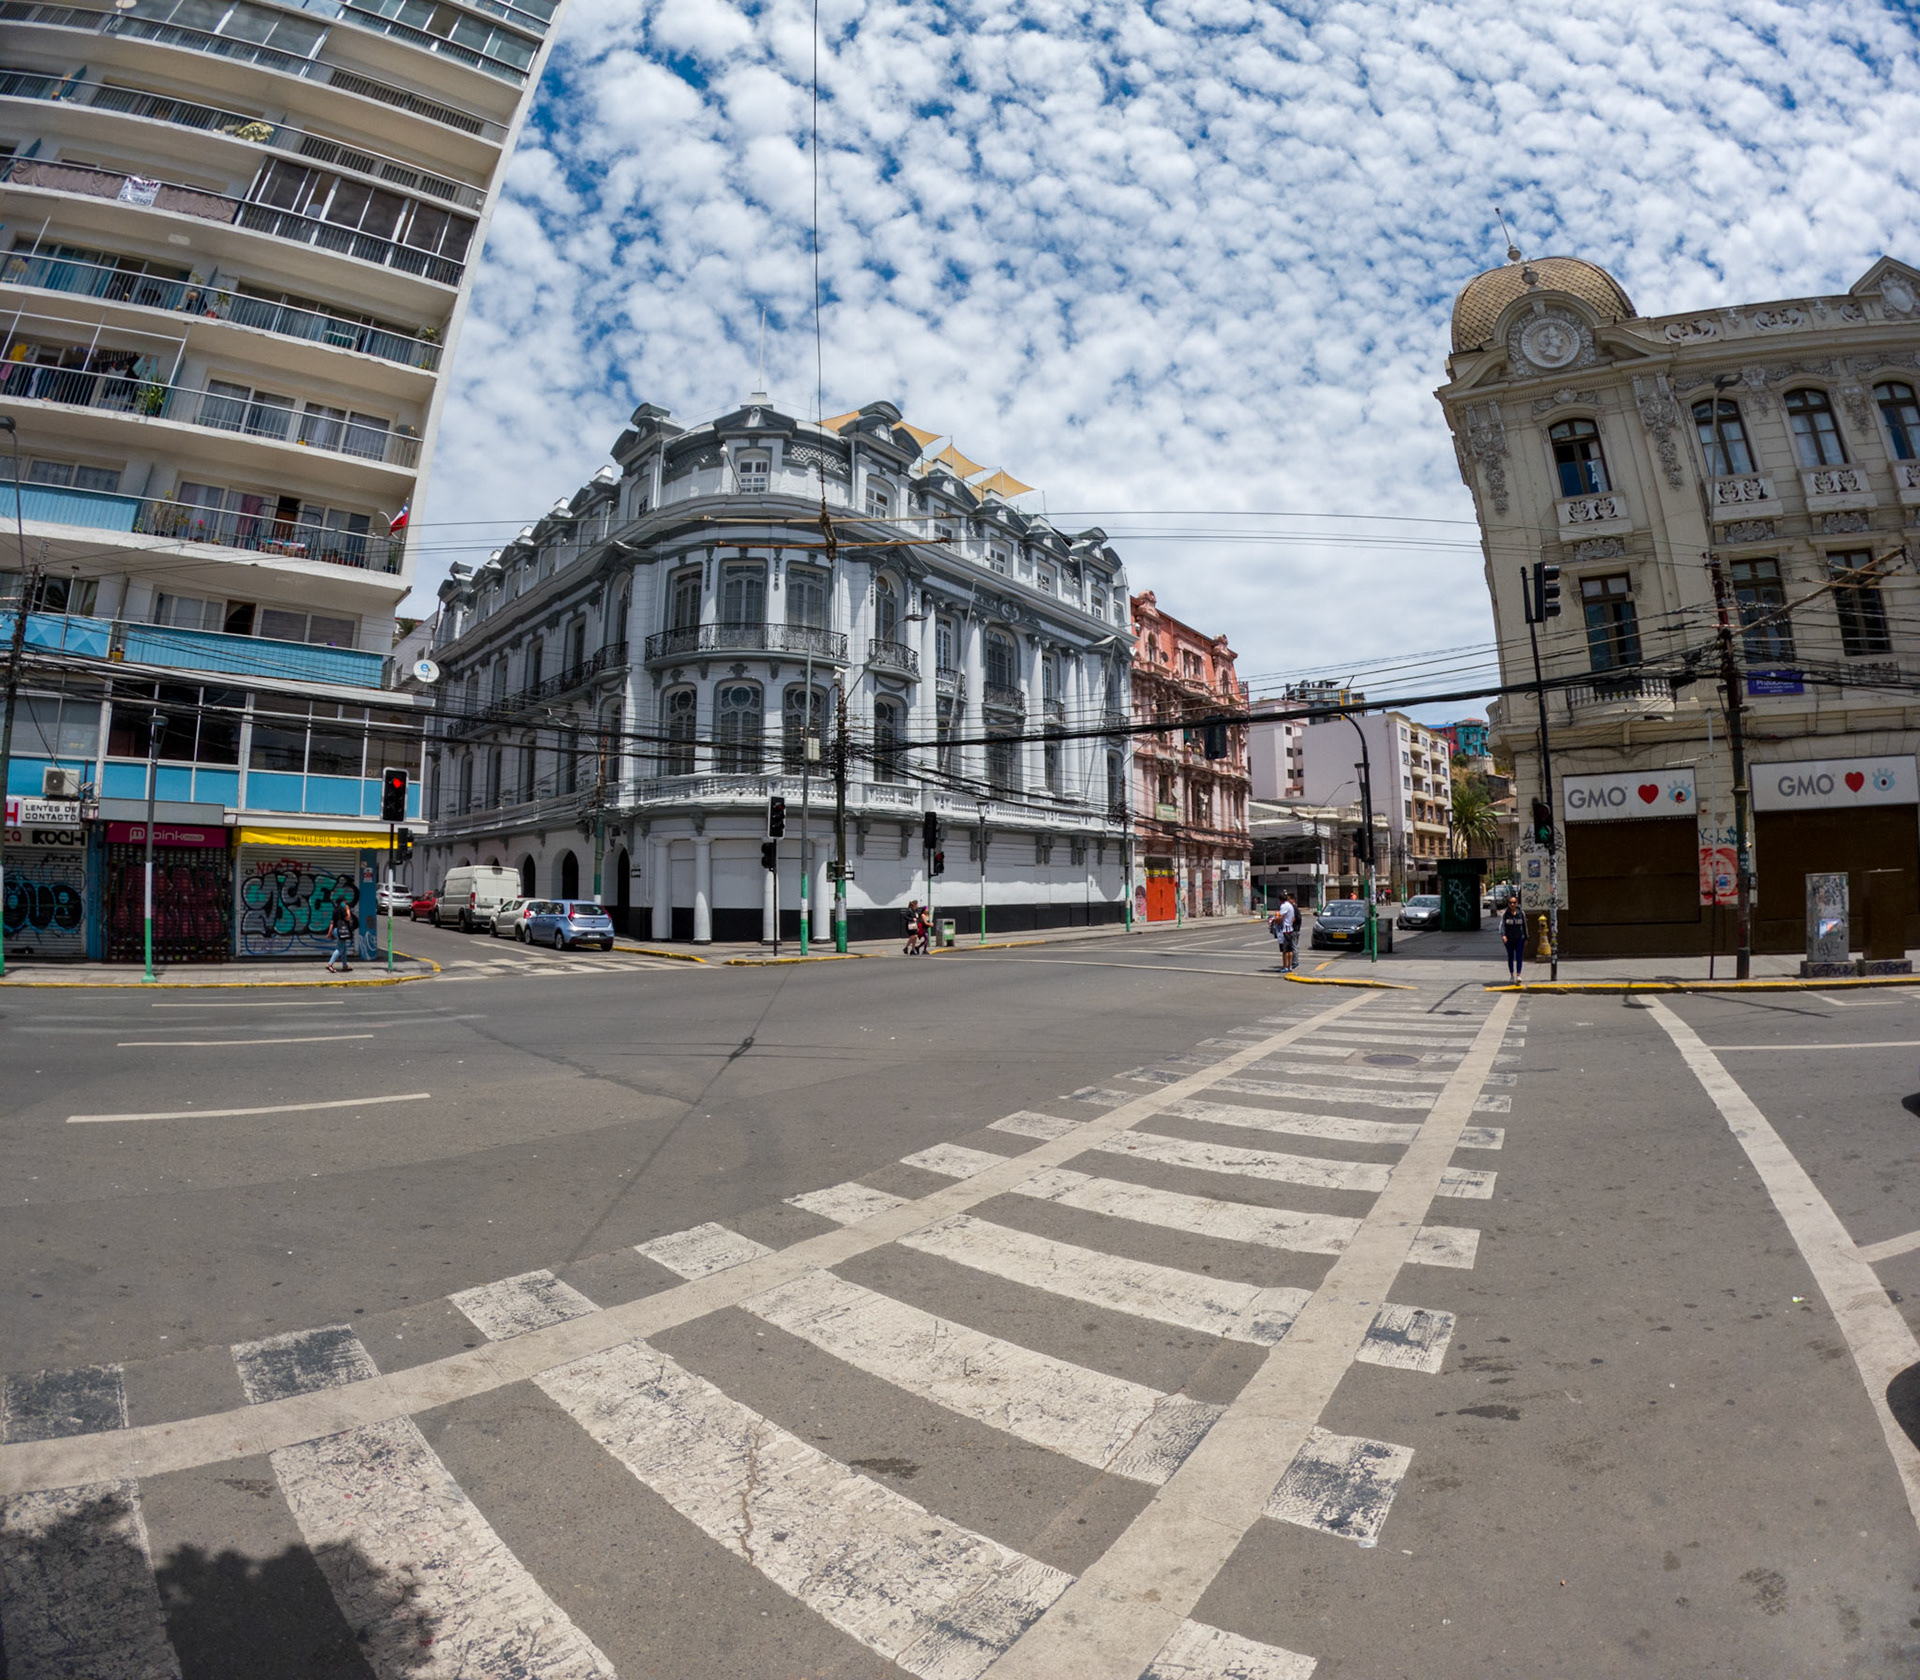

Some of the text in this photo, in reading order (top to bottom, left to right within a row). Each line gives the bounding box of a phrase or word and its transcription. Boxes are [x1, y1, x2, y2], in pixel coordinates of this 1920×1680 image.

[1778, 773, 1835, 797] GMO
[1568, 786, 1627, 809] GMO
[25, 804, 60, 812] LENTES
[25, 813, 77, 821] CONTACTO
[32, 830, 86, 846] KOCH
